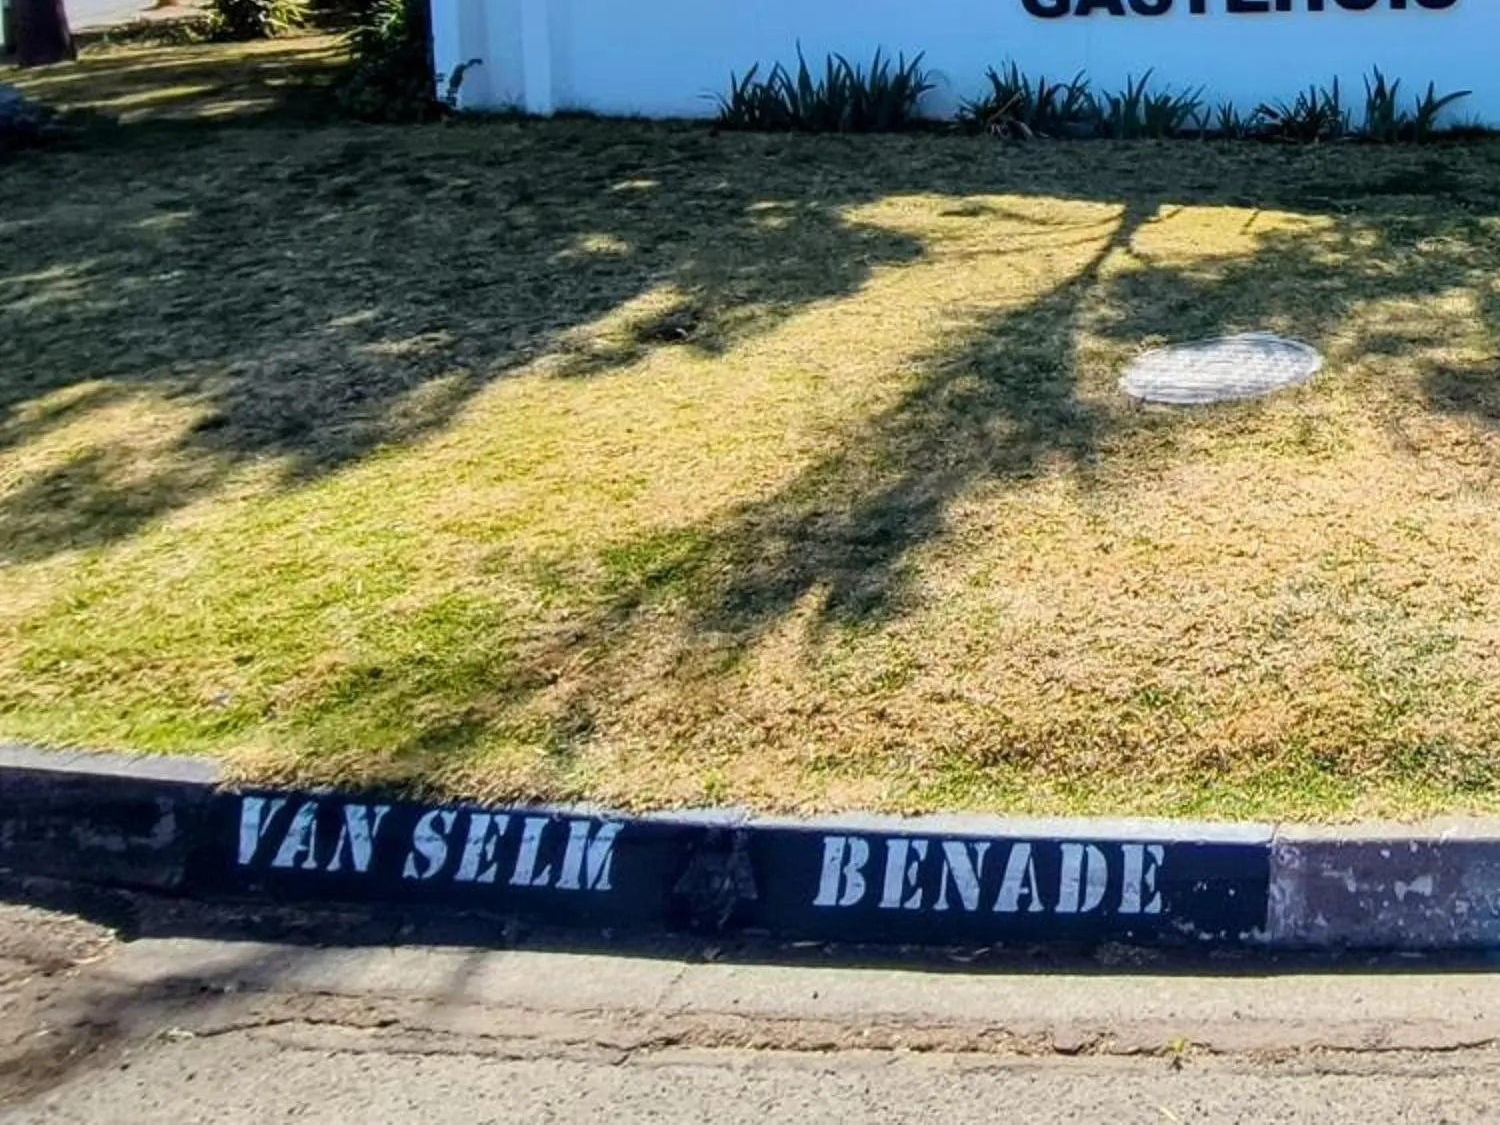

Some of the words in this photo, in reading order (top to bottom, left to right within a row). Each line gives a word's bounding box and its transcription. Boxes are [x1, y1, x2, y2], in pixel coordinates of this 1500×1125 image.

[237, 795, 391, 873] VAN
[402, 809, 625, 891] SELM
[812, 836, 1166, 914] BENADE
